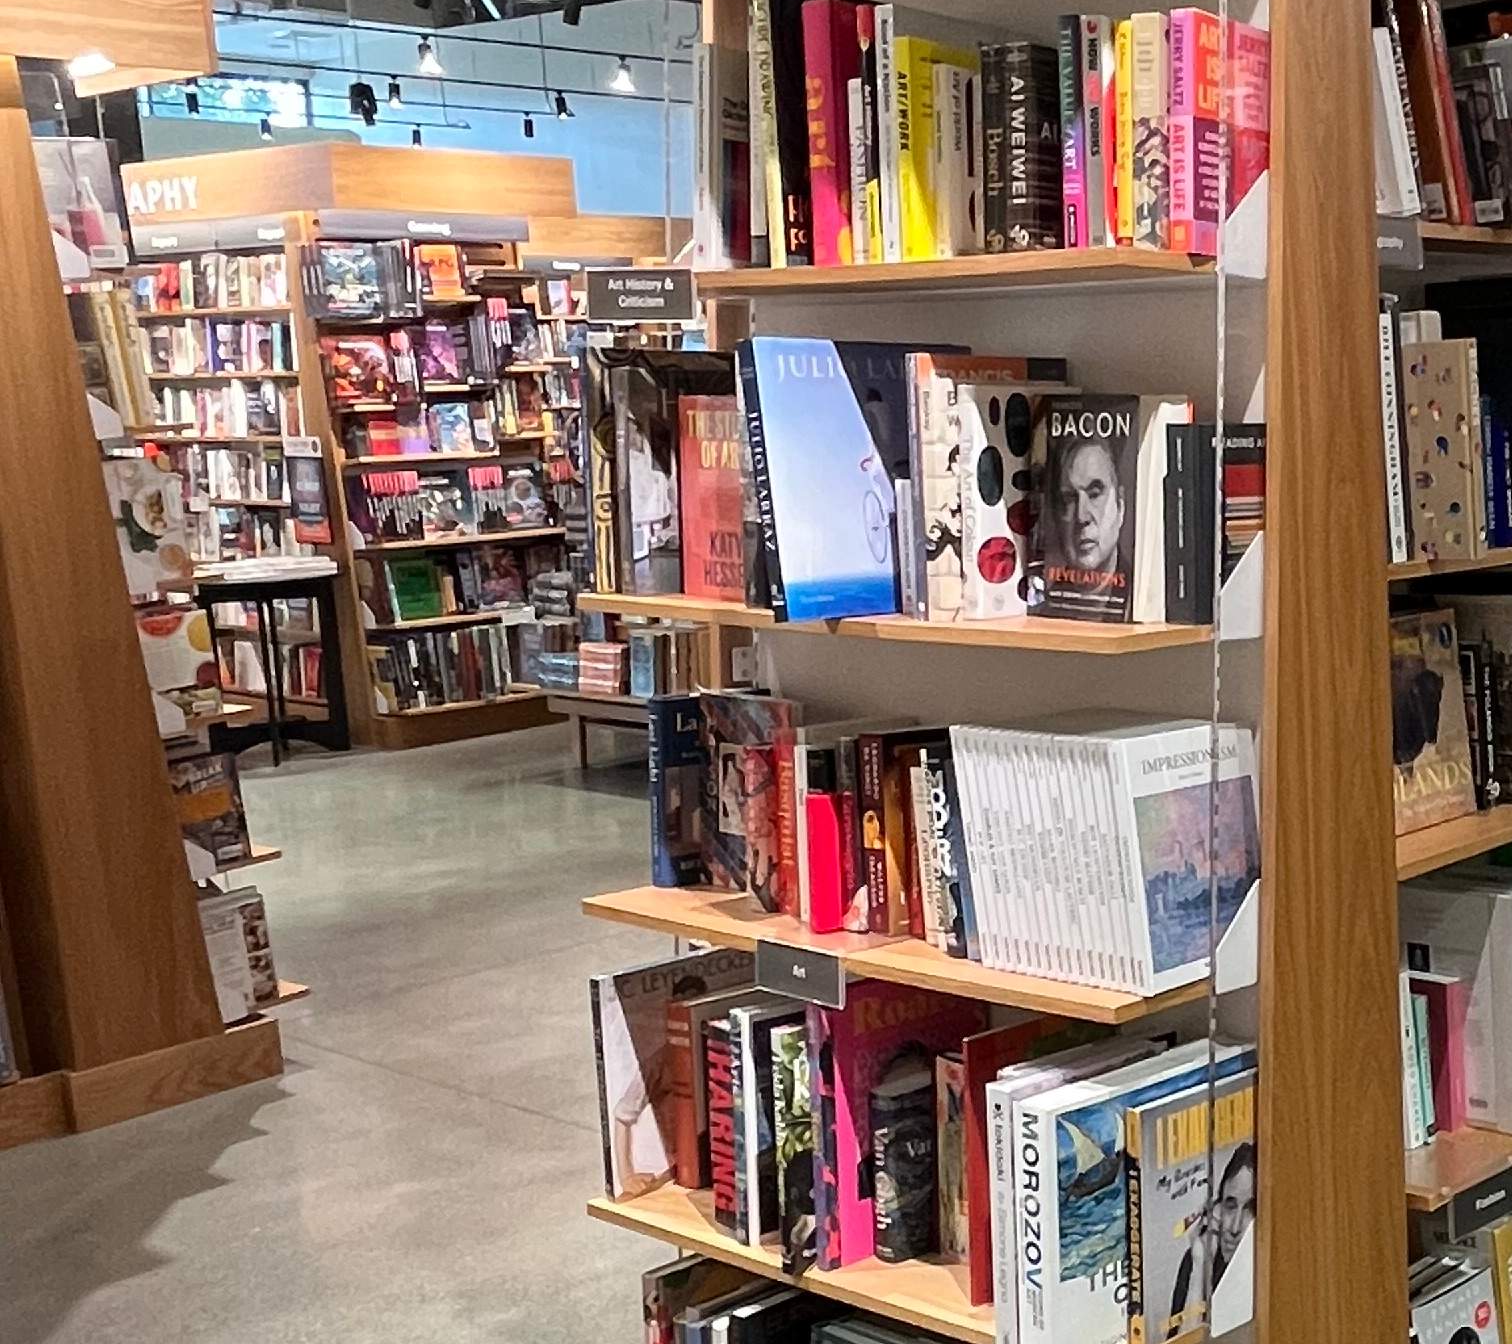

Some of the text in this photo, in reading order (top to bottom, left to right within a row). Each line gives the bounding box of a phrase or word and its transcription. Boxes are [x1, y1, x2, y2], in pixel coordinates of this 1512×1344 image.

[1173, 21, 1185, 107] JERRY SALTZ
[897, 70, 911, 152] ART/WORK
[1011, 76, 1027, 205] AI WEIWEI
[987, 128, 1004, 197] Bosch
[1063, 136, 1077, 170] ART
[1173, 123, 1185, 213] ART IS LIFE
[625, 277, 662, 293] History
[700, 441, 718, 469] OF
[748, 412, 764, 465] JULIO
[1051, 411, 1131, 439] BACON
[874, 1126, 891, 1169] Van
[1020, 1111, 1044, 1291] MOROZOV
